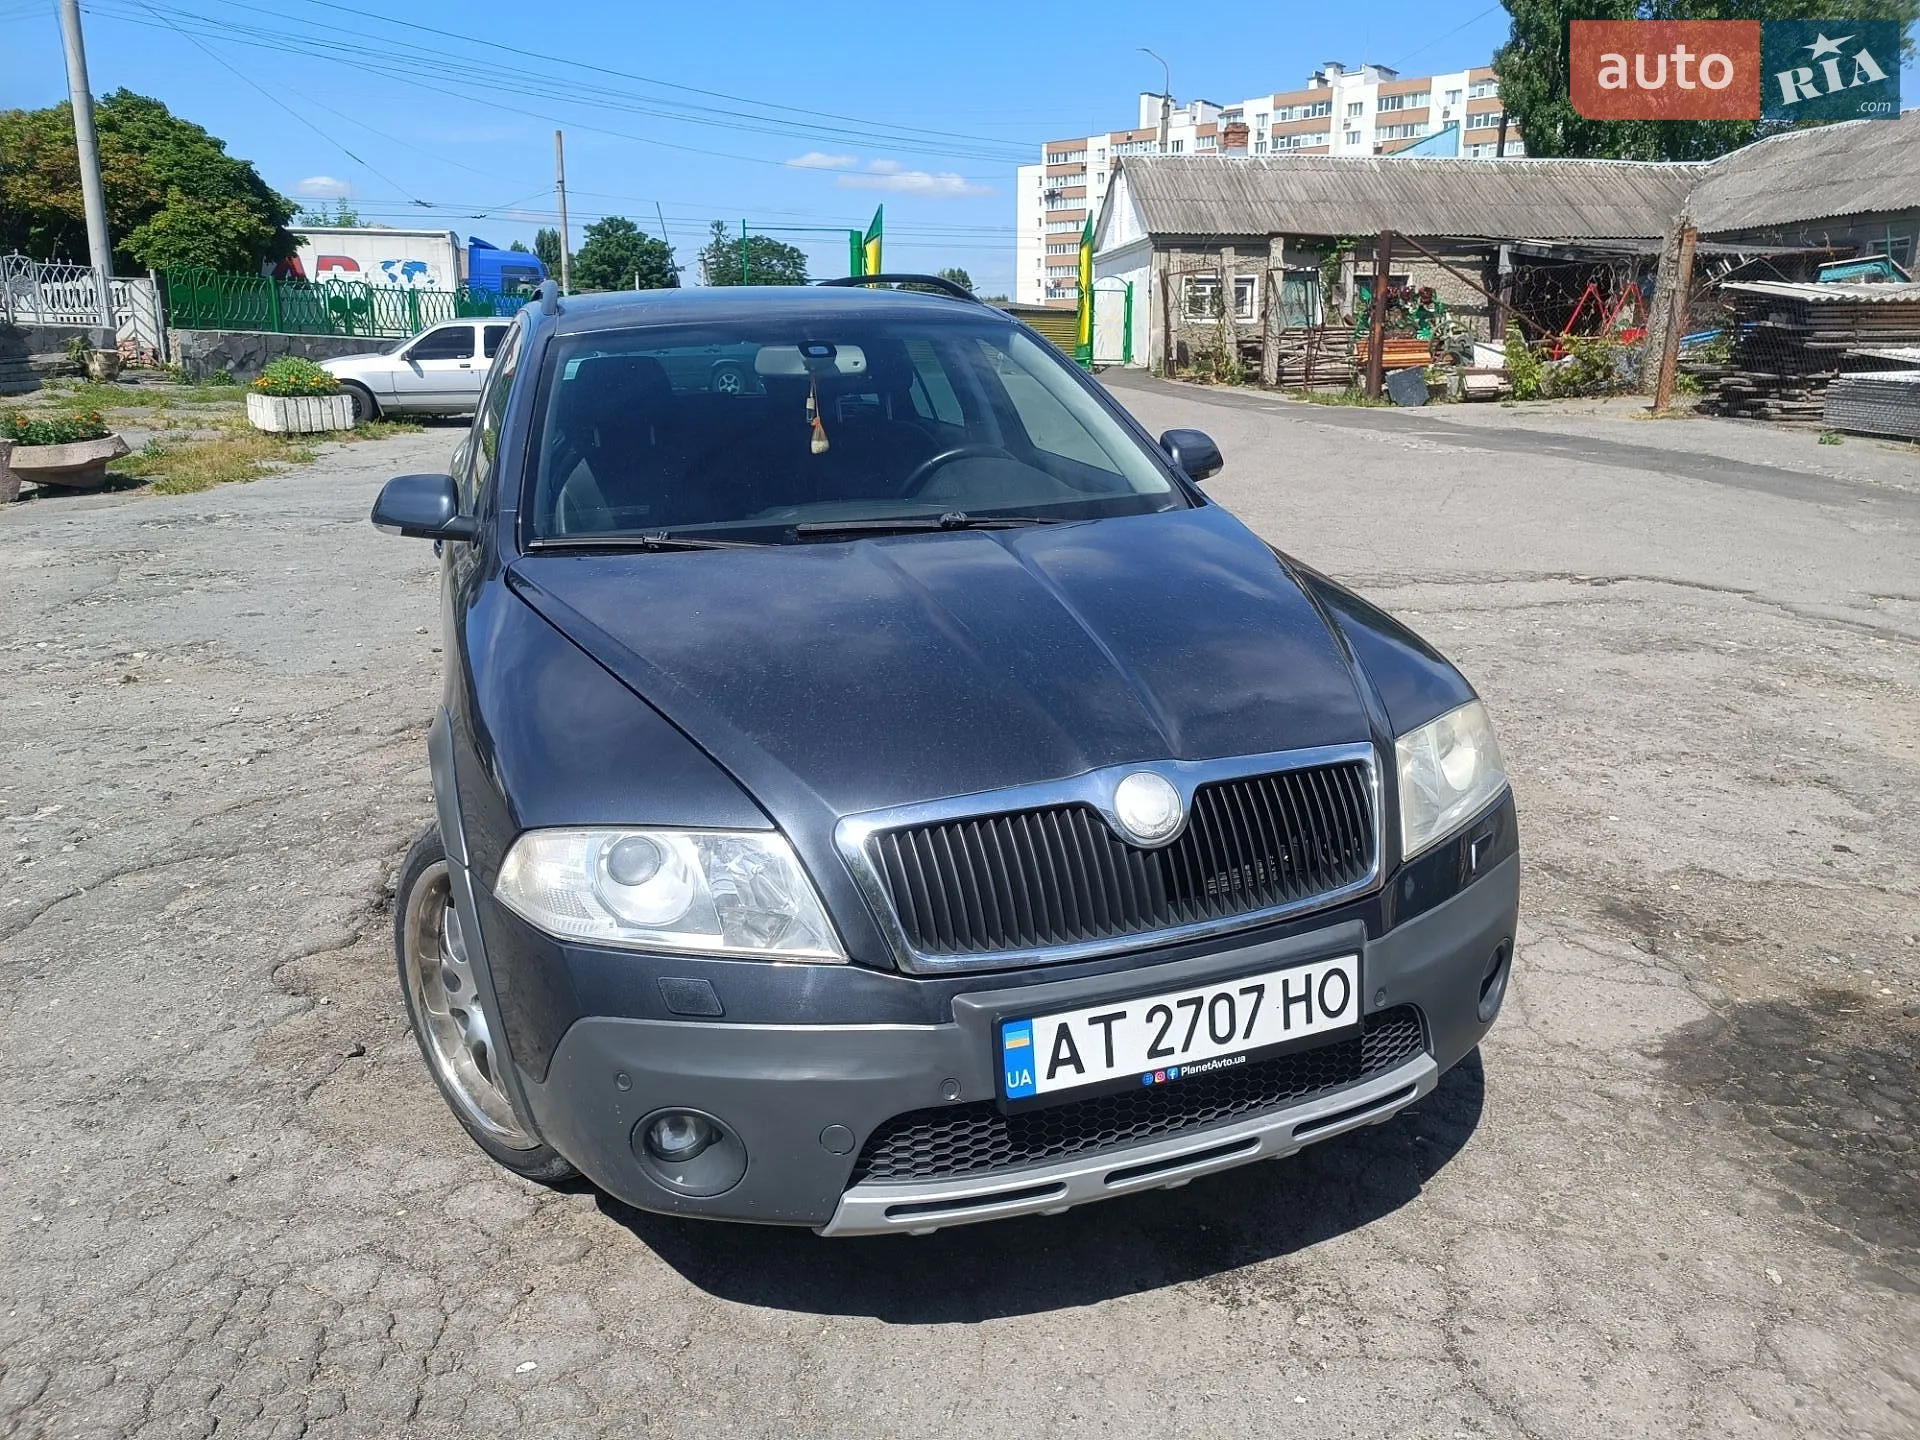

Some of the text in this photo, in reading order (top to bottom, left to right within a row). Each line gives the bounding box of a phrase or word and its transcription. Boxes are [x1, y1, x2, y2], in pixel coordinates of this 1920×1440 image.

[1046, 967, 1351, 1079] AT 2707 HO
[1181, 1055, 1246, 1076] PlanetAvto.ua
[1007, 1068, 1032, 1089] UA
